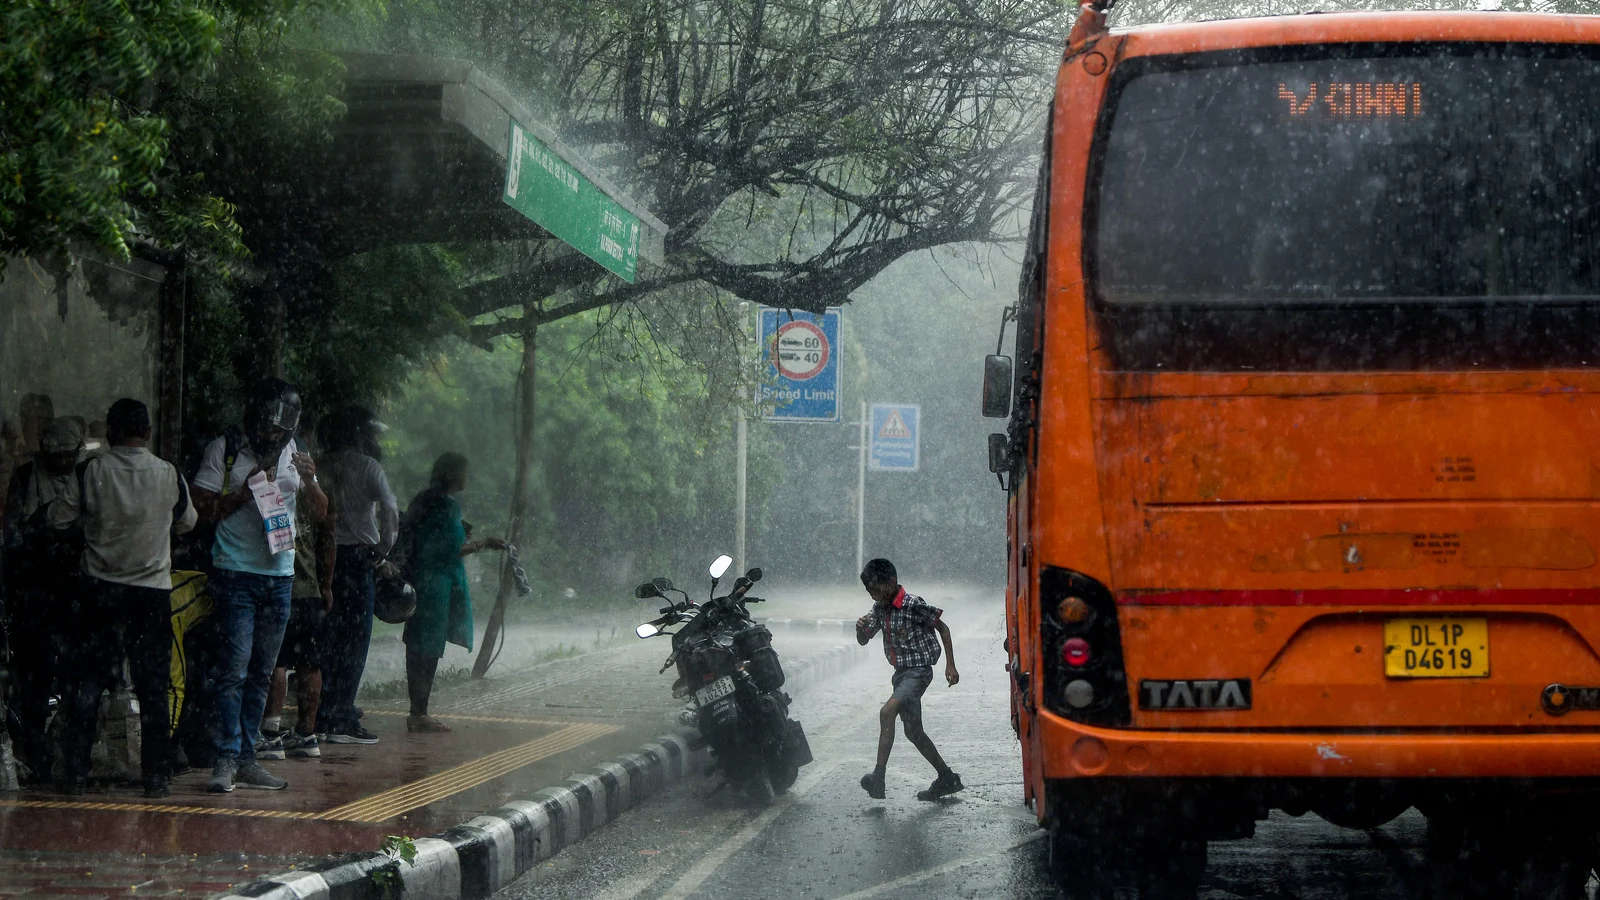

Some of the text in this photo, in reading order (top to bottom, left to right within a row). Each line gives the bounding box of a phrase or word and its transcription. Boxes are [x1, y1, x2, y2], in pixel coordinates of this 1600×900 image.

[804, 337, 819, 348] 60
[804, 353, 819, 363] 40
[804, 388, 835, 401] Limit
[1411, 624, 1464, 647] DL1P
[1405, 648, 1472, 671] D4619
[1143, 680, 1247, 707] TATA
